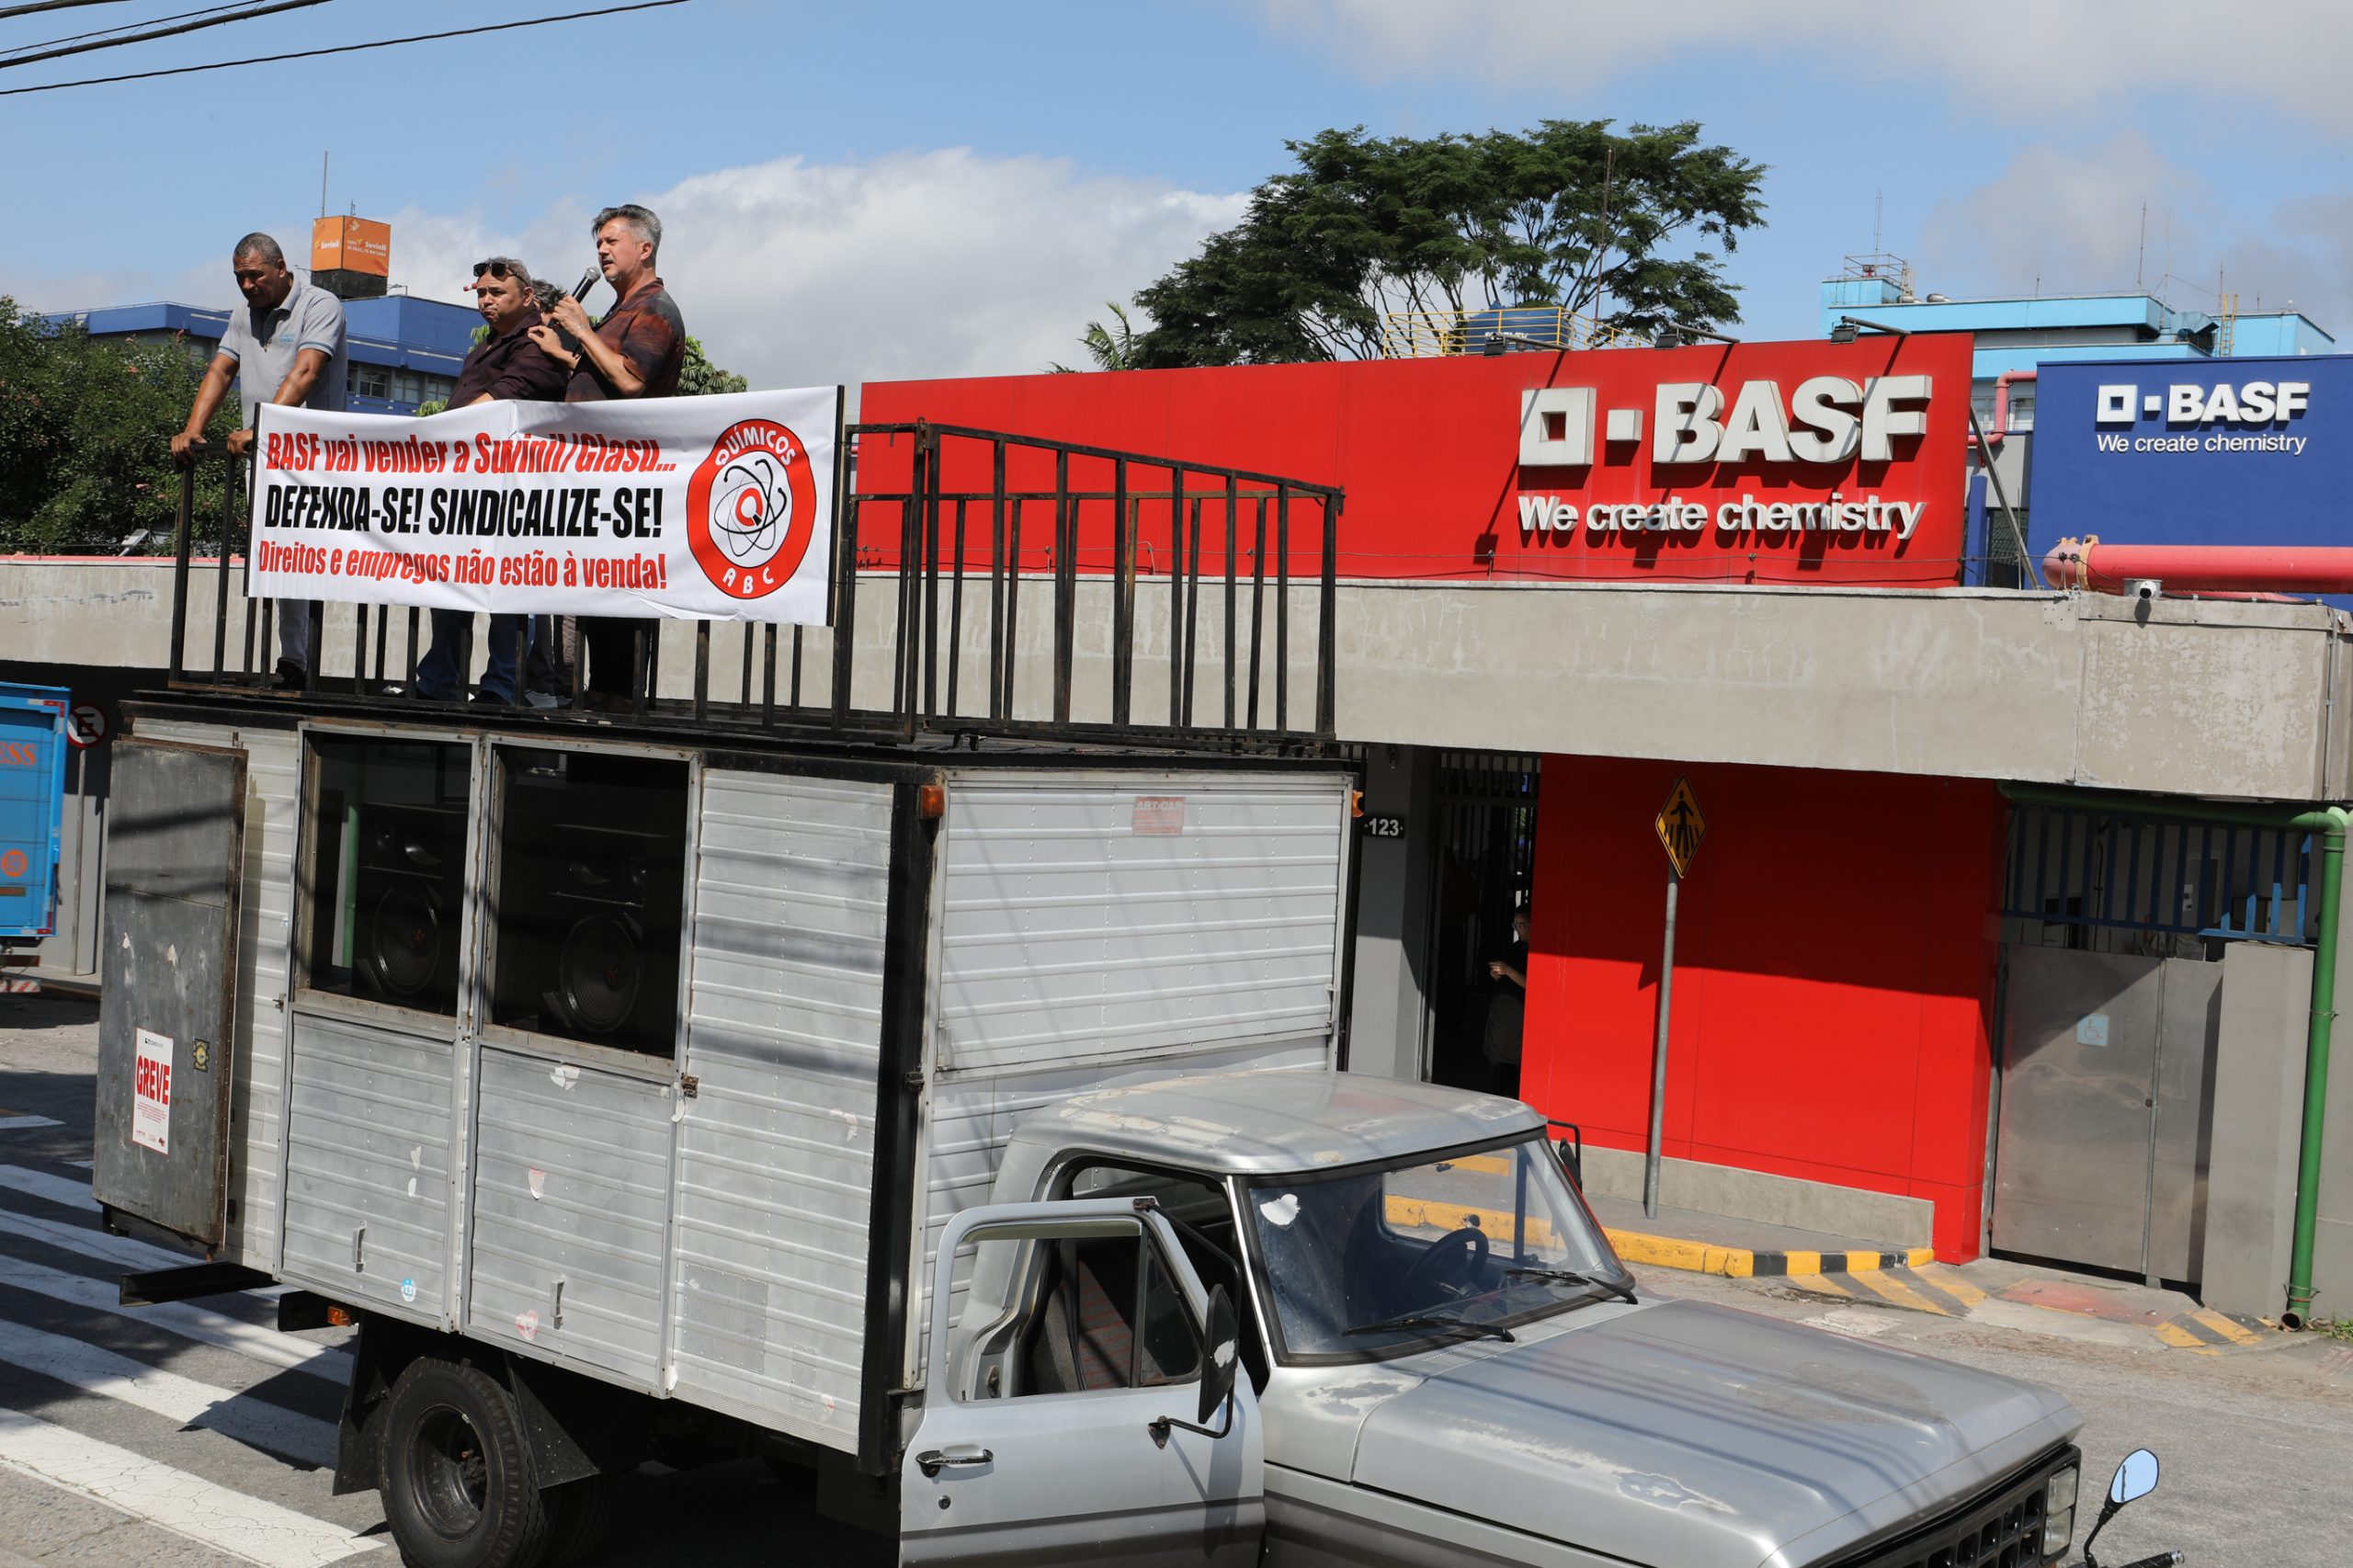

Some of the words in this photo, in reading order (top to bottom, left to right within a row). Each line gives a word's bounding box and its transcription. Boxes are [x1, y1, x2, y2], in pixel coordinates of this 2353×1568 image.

[365, 241, 386, 251] Suvinil
[1653, 375, 1933, 463] BASF
[2167, 381, 2310, 423] BASF
[266, 432, 321, 471] BASF
[324, 434, 358, 472] vai
[361, 435, 448, 473] vender
[453, 440, 471, 473] a
[714, 426, 796, 466] QUÍMICOS
[2097, 434, 2130, 452] We
[2134, 434, 2199, 452] create
[2204, 433, 2307, 455] chemistry
[265, 484, 424, 534] DEFENDA-SE!
[428, 486, 663, 539] SINDICALIZE-SE!
[1518, 495, 1579, 530] We
[1586, 496, 1708, 530] create
[1716, 493, 1927, 540] chemistry
[258, 540, 326, 574] Direitos
[330, 549, 343, 574] e
[346, 549, 450, 585] empregos
[454, 548, 495, 585] não
[499, 549, 558, 587] estão
[563, 550, 577, 587] à
[582, 552, 667, 589] venda!
[1370, 818, 1399, 836] 123
[136, 1054, 170, 1106] GREVE
